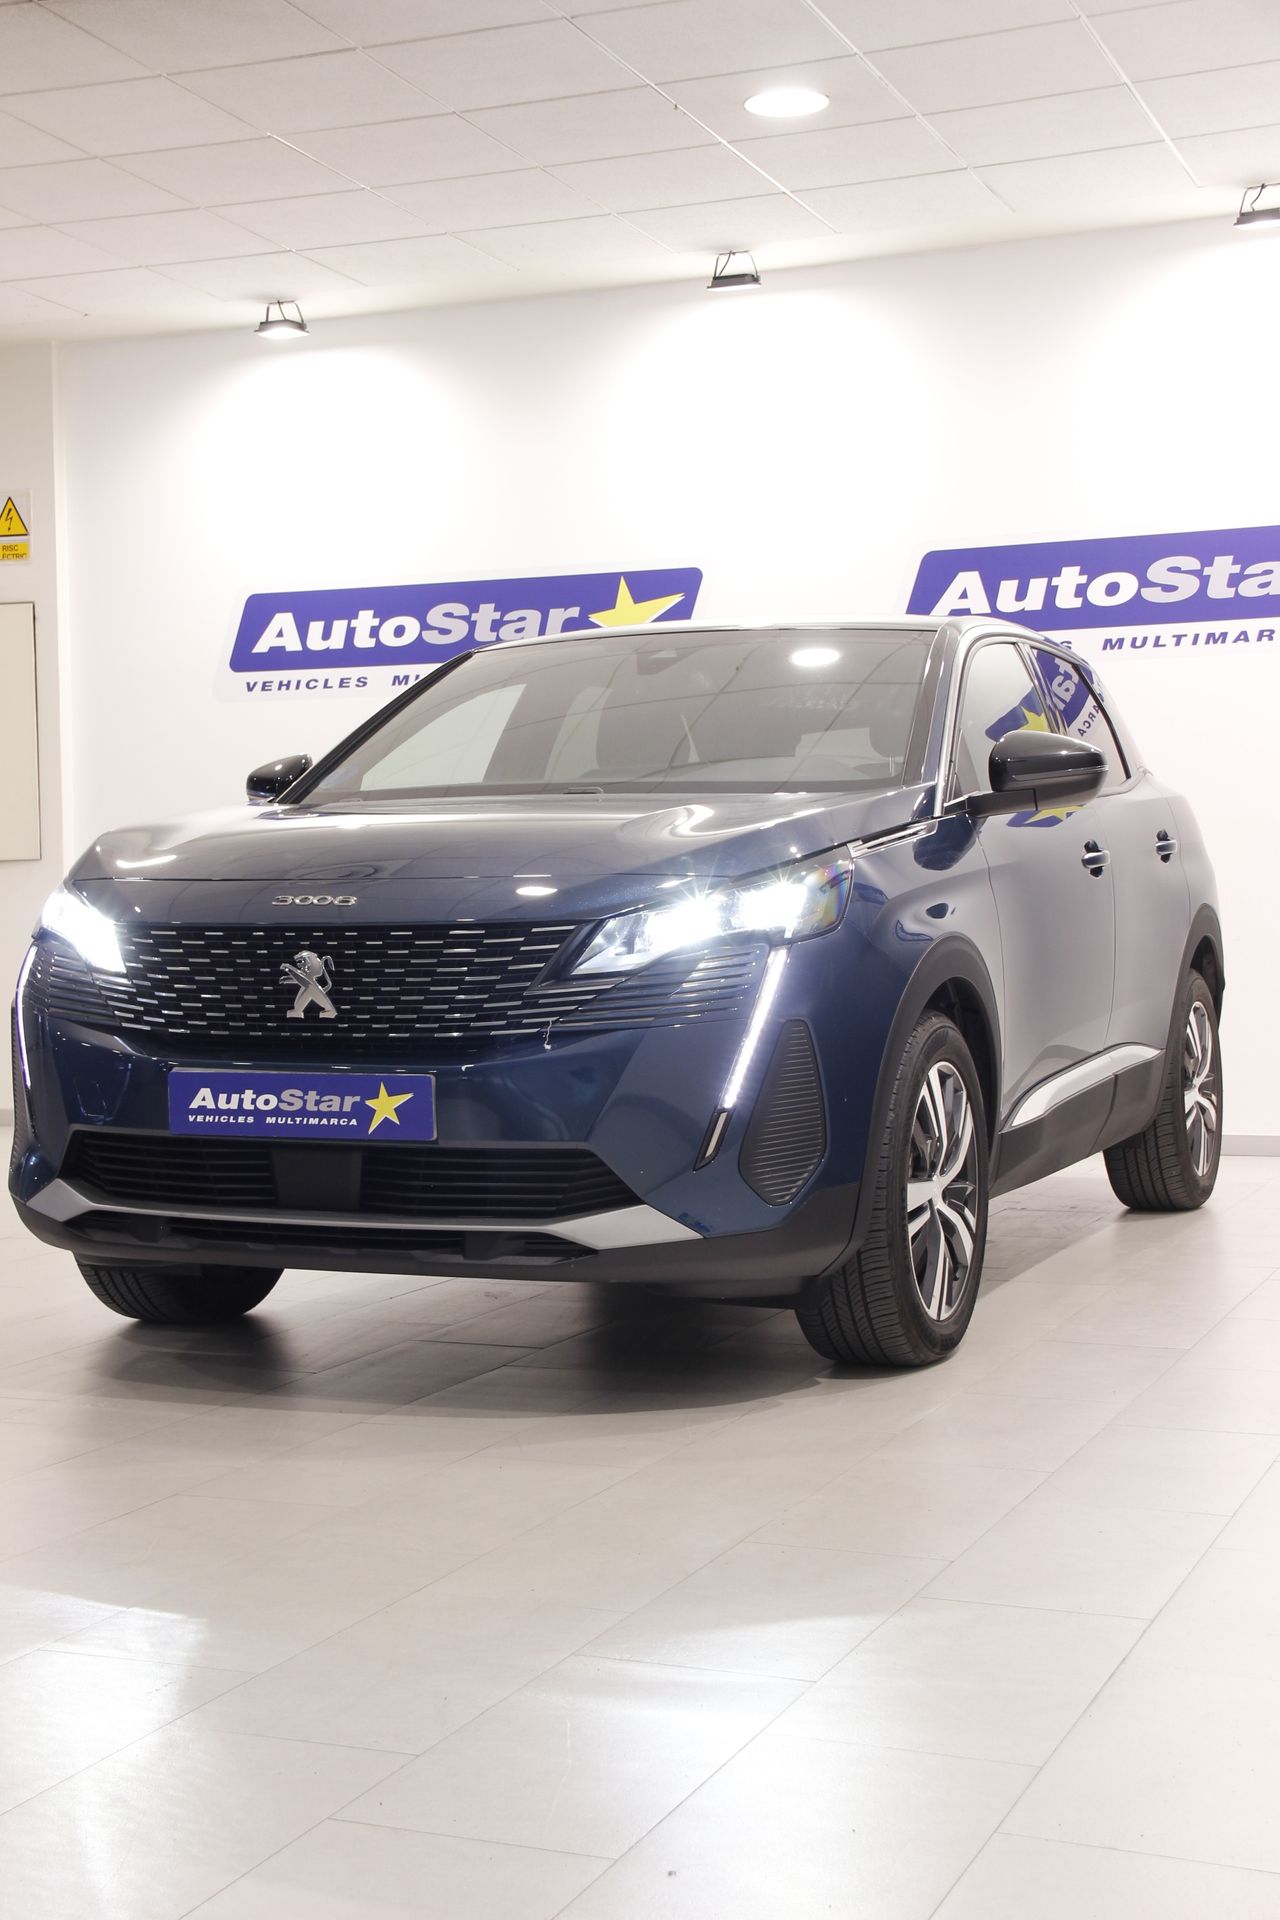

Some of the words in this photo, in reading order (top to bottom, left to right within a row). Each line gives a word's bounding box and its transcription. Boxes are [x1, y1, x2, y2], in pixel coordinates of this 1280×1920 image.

[251, 602, 580, 653] AutoStar
[1102, 628, 1276, 651] MULTIMAR
[246, 676, 369, 692] VEHICLES
[189, 1087, 360, 1112] AutoStar
[188, 1115, 255, 1124] VEHICLES
[266, 1116, 358, 1126] MULTIMARCA
